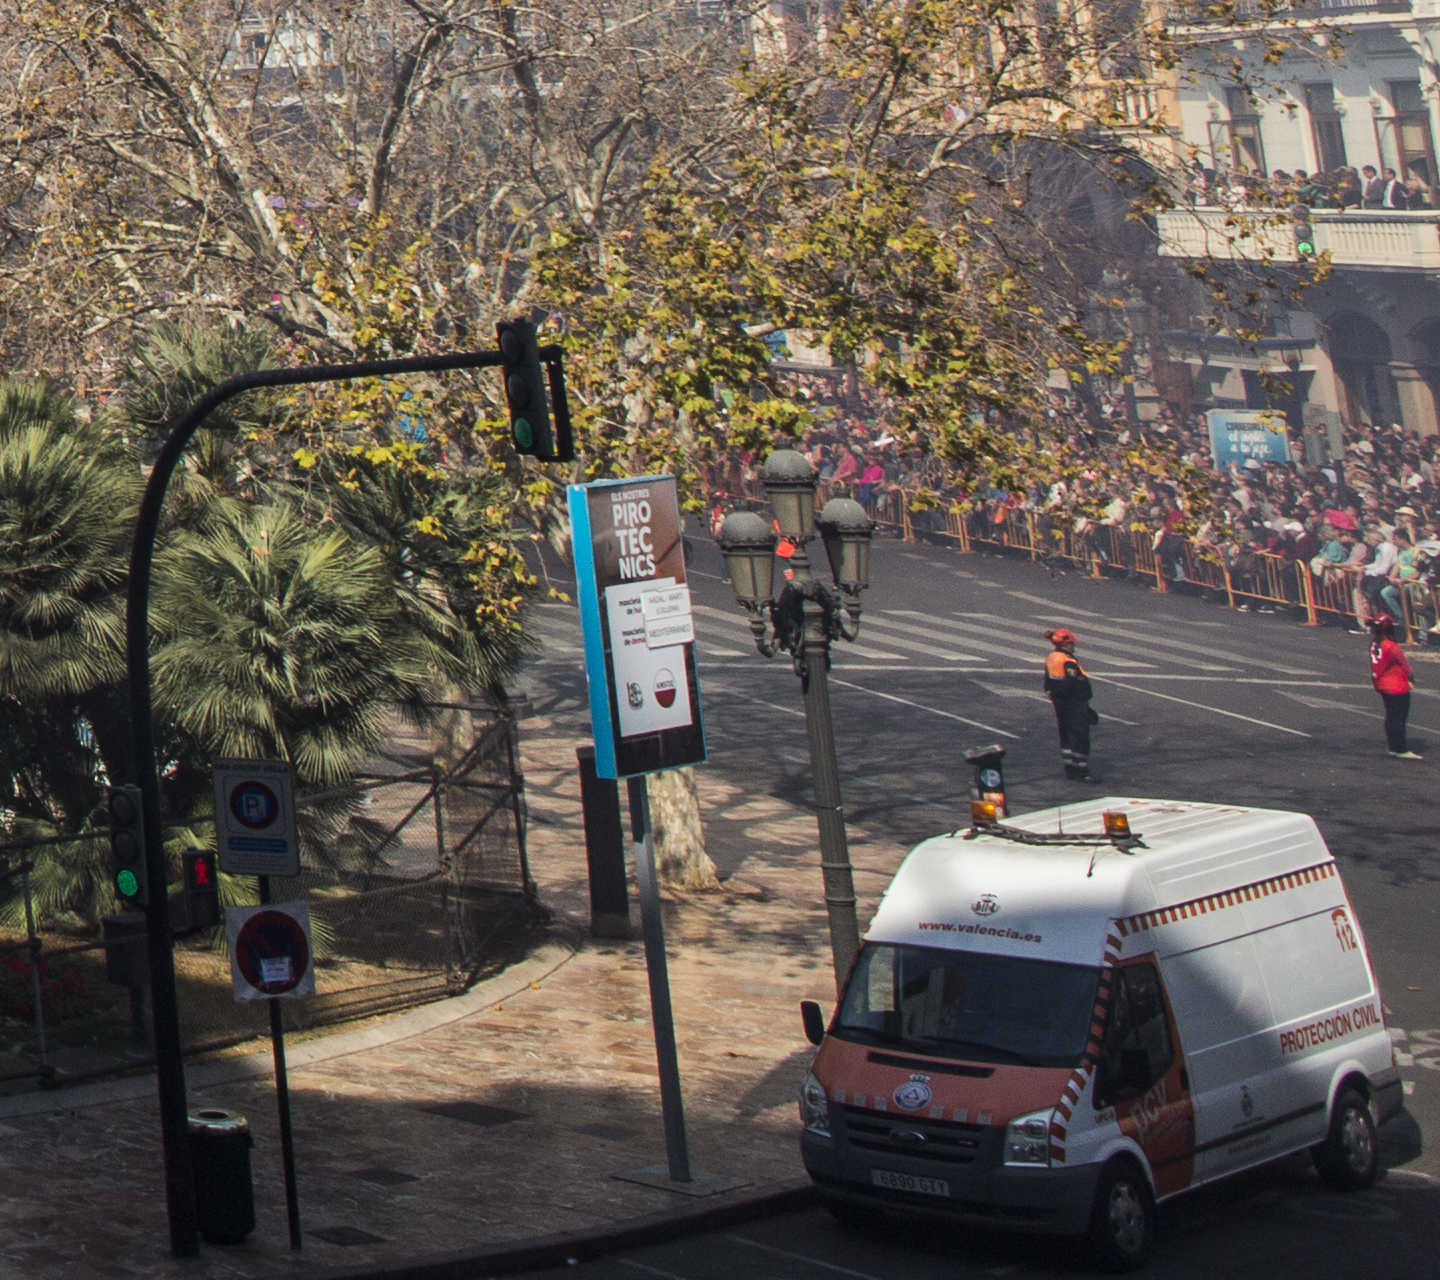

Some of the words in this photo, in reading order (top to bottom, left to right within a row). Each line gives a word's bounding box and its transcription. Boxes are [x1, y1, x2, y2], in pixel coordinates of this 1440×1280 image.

[612, 500, 652, 527] PIRO
[615, 525, 654, 556] TEC
[618, 553, 656, 580] NICS
[918, 921, 1042, 943] www.valencia.es
[1336, 924, 1358, 952] 112
[1280, 1010, 1352, 1055] PROTECCIÓN
[1353, 1002, 1380, 1030] CIVIL
